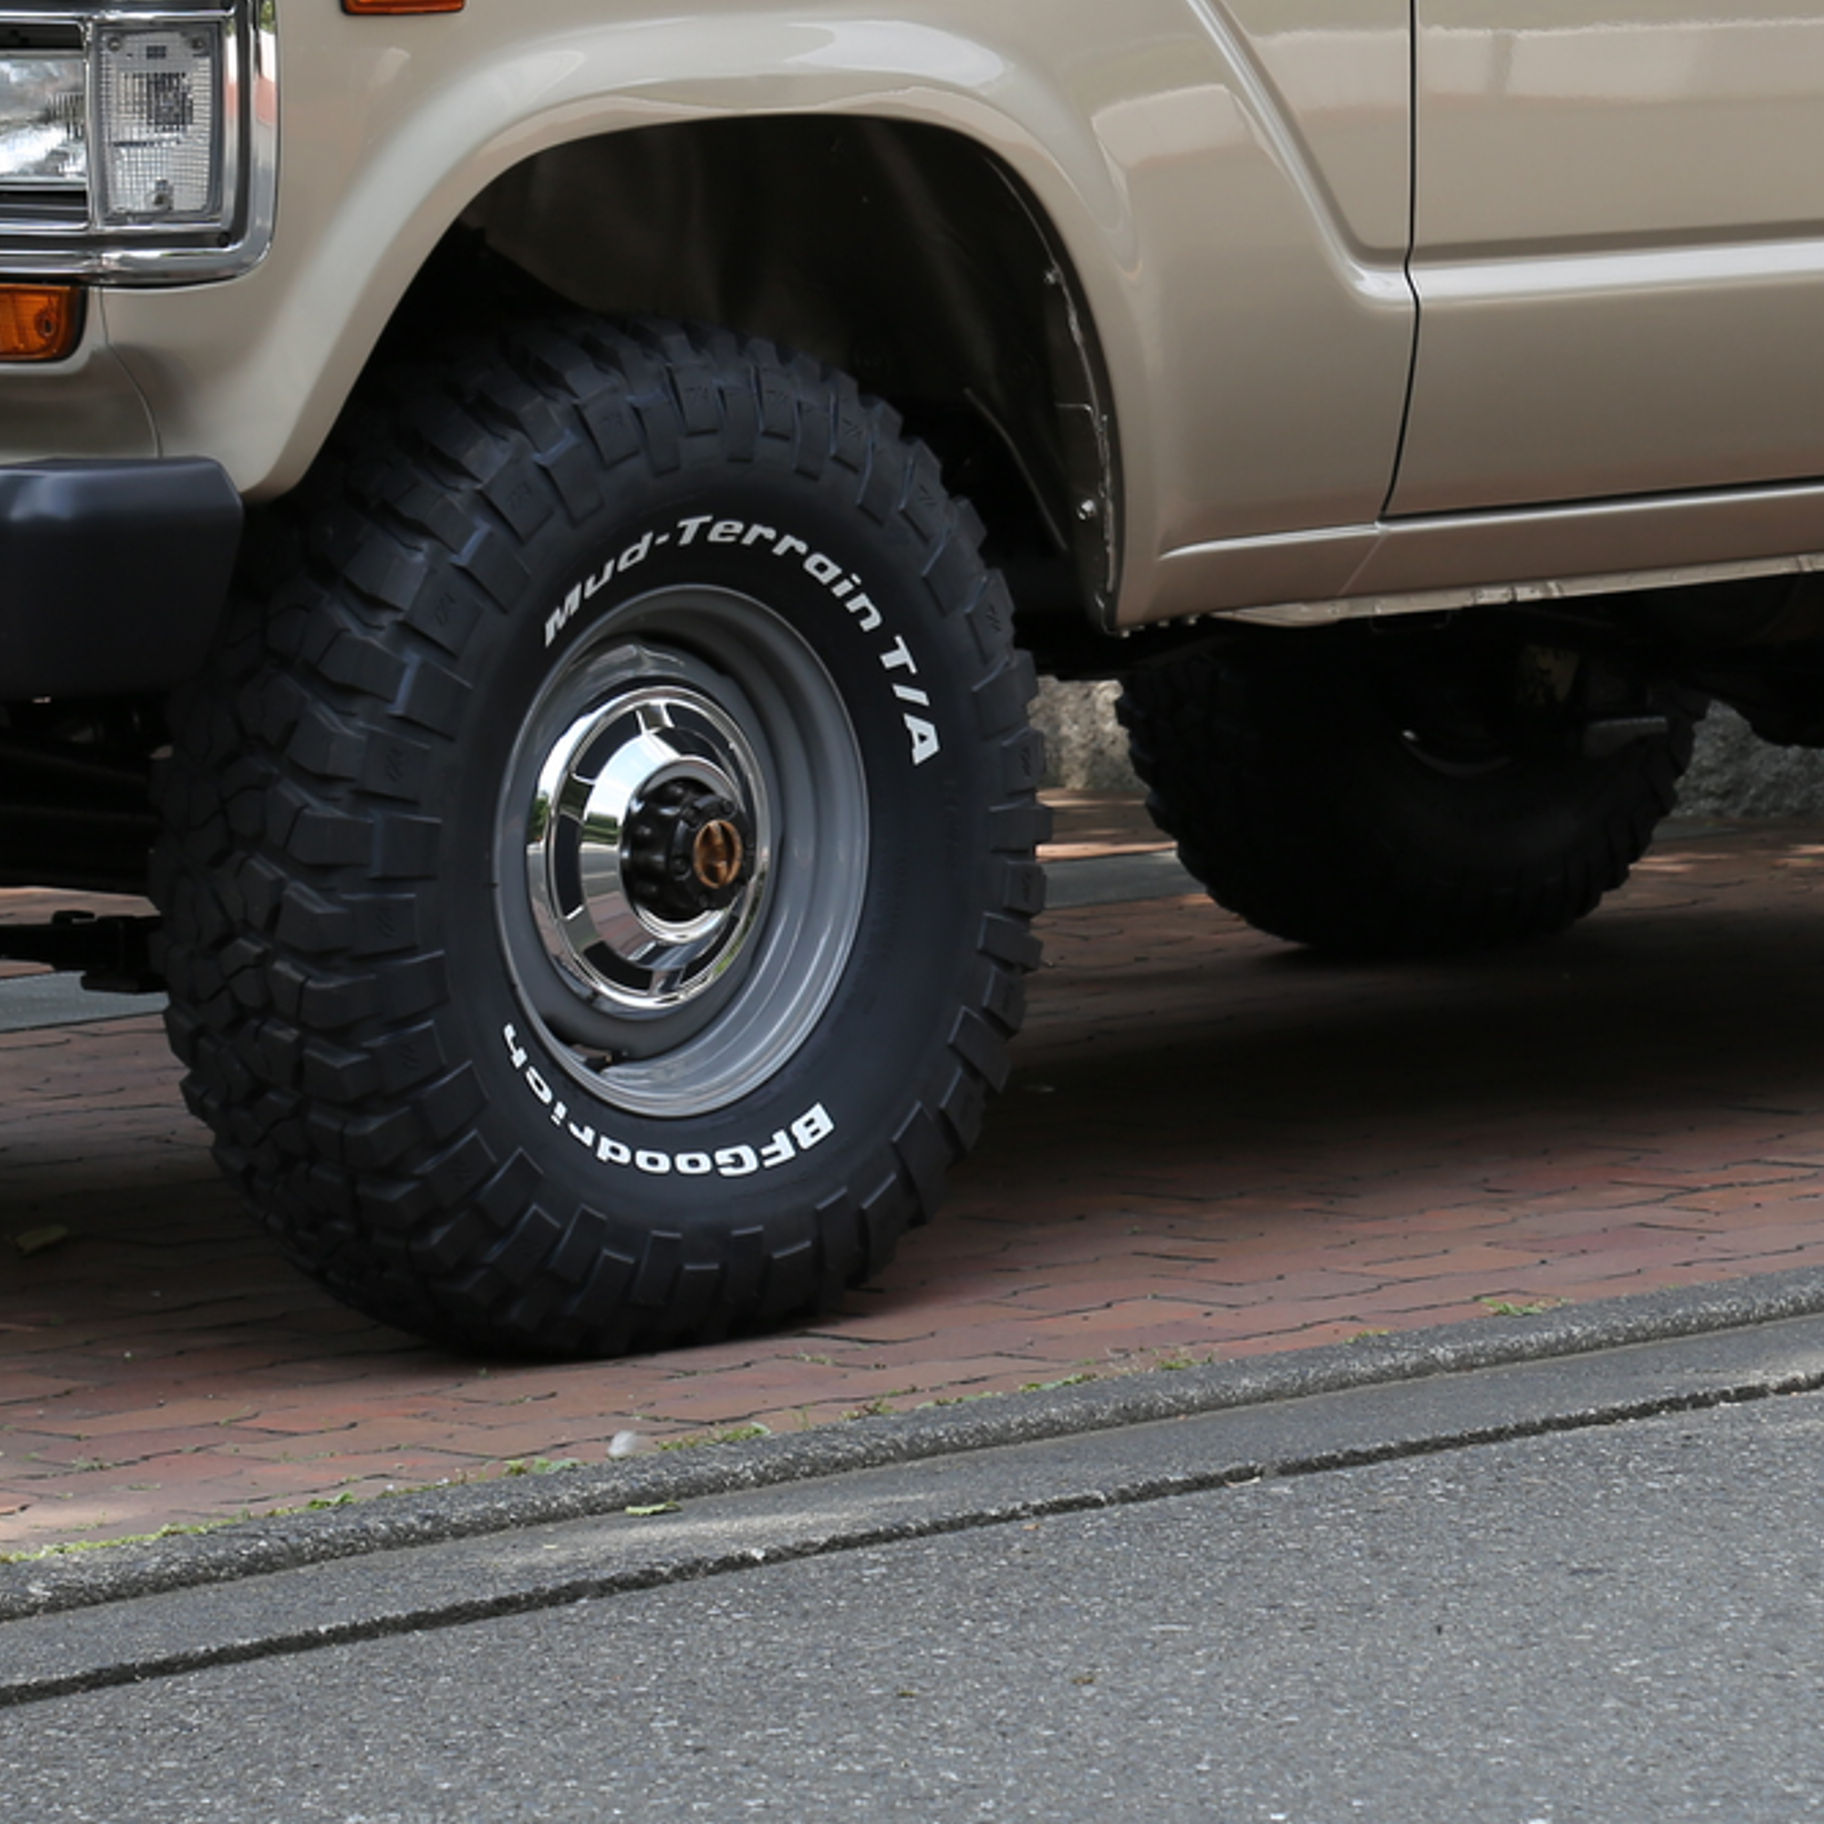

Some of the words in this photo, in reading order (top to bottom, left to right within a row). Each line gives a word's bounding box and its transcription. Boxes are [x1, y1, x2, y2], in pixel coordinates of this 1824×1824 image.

[544, 514, 881, 648] Mud-Terrain
[879, 635, 940, 766] T/A
[502, 1022, 835, 1176] BFGoodrich
